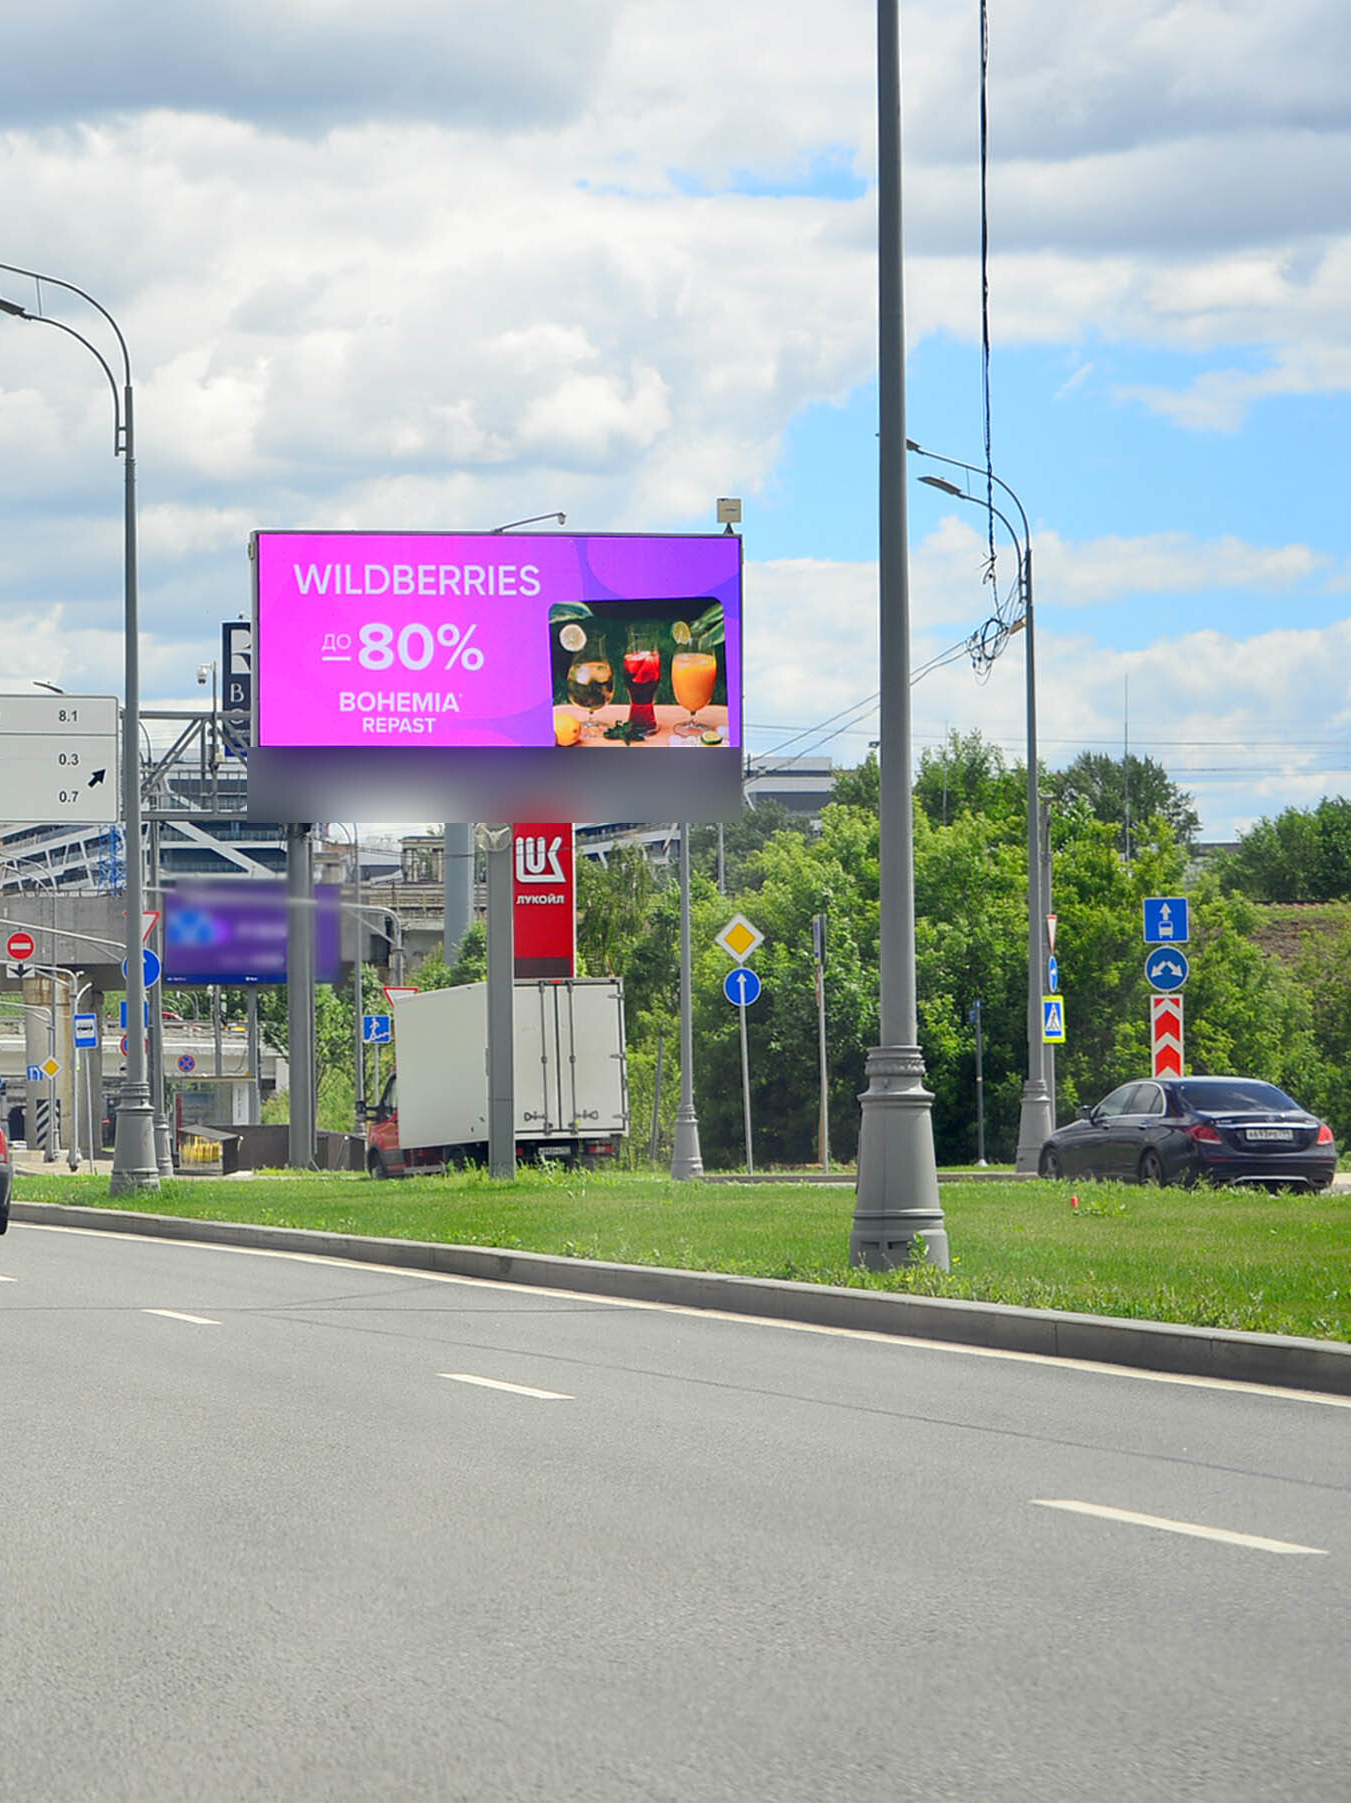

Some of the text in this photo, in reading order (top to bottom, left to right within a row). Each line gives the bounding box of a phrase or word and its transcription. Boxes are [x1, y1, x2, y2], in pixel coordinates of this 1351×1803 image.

[293, 563, 541, 597] WILDBERRIES
[58, 709, 78, 722] 8.1
[362, 716, 437, 734] REPAST
[58, 753, 79, 766] 0.3
[58, 790, 79, 803] 0.7
[515, 892, 565, 905] ЛУКОЙЛ
